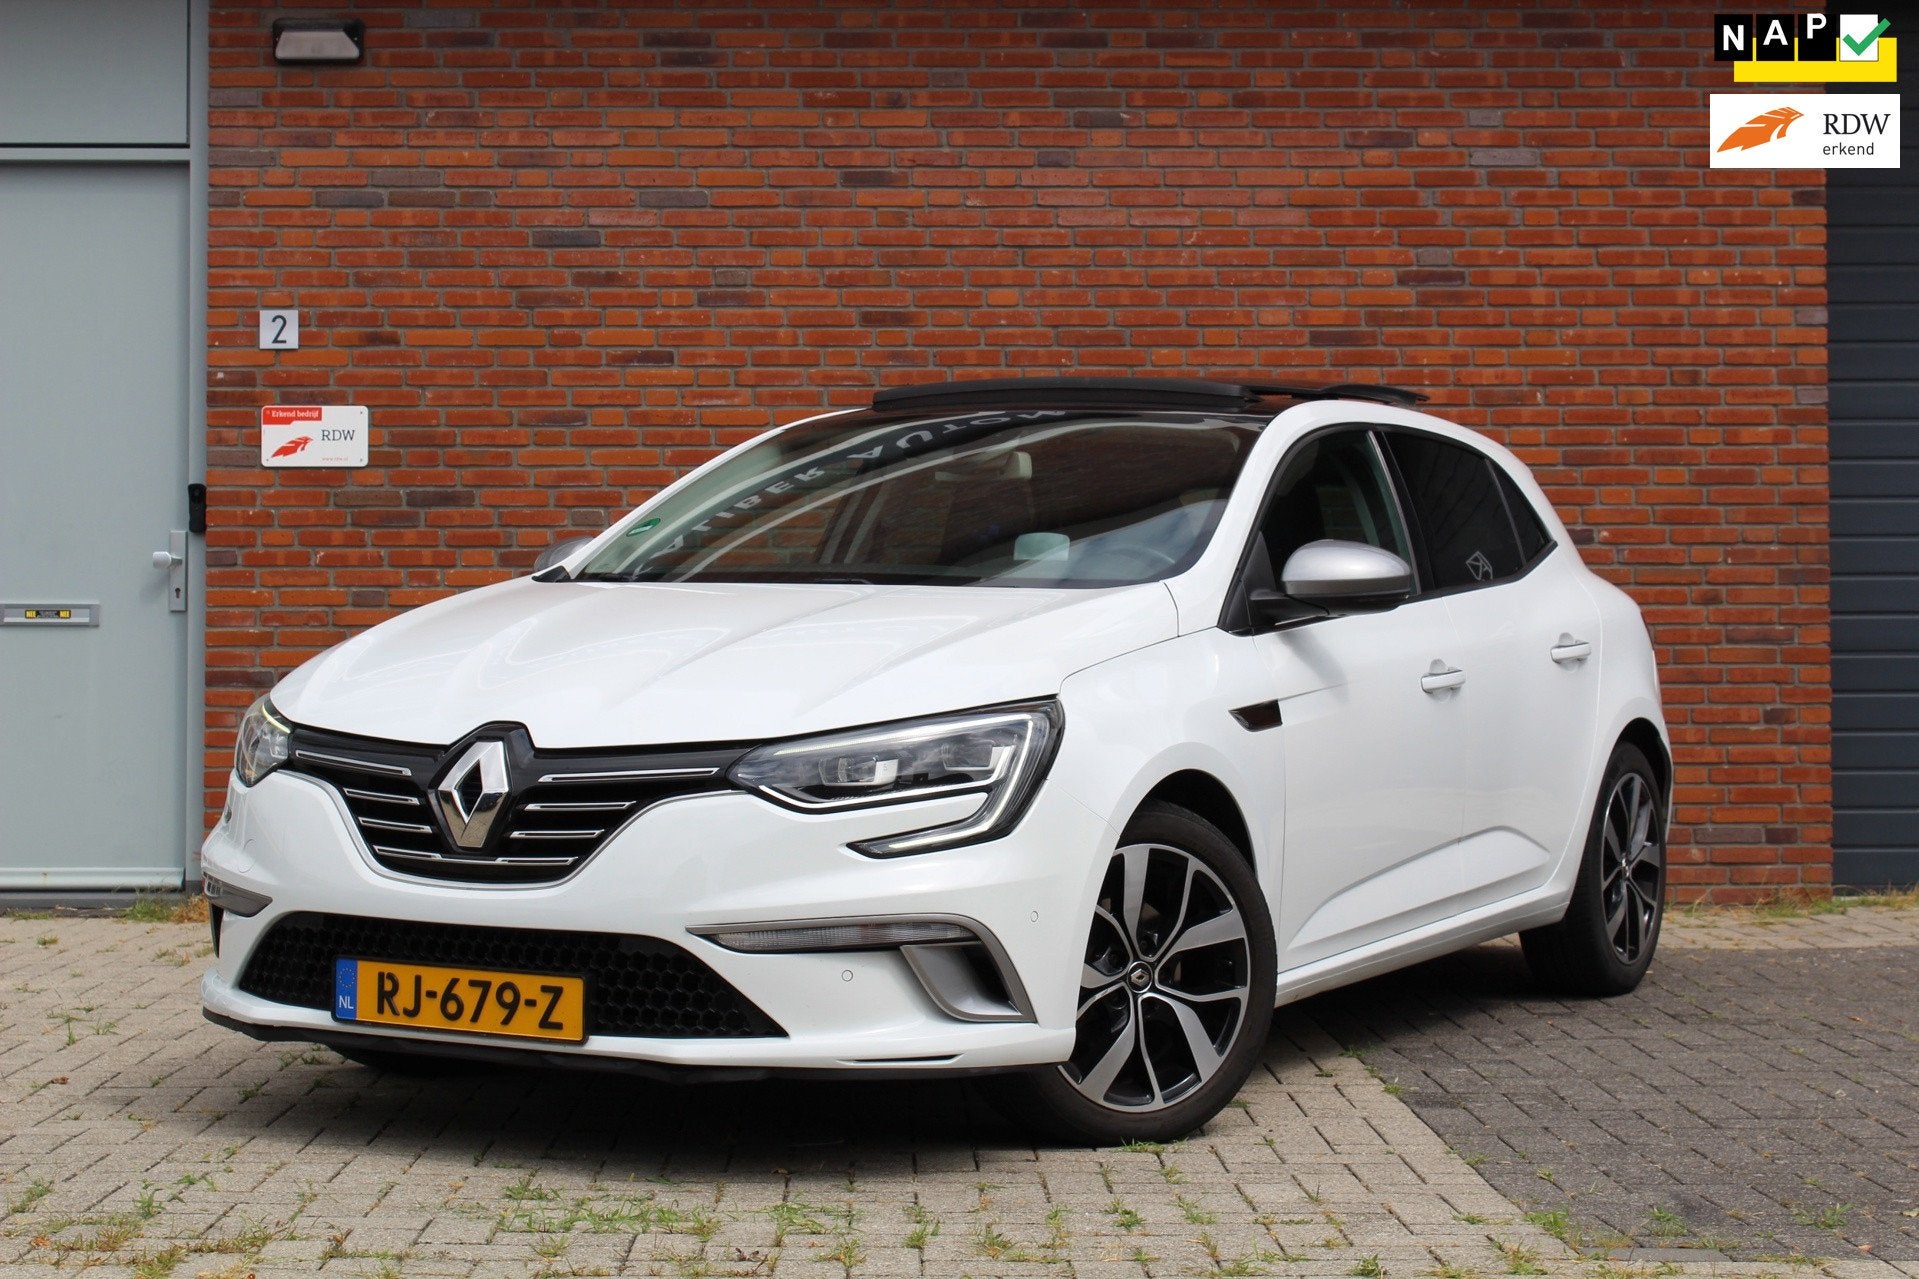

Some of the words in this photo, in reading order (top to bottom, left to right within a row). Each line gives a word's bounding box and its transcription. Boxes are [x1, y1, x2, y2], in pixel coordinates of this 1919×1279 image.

[271, 314, 287, 344] 2
[272, 410, 296, 418] Erkend
[297, 410, 319, 418] bedrijf
[321, 429, 355, 441] RDW
[338, 995, 354, 1009] NL
[376, 971, 564, 1030] RJ-679-Z
